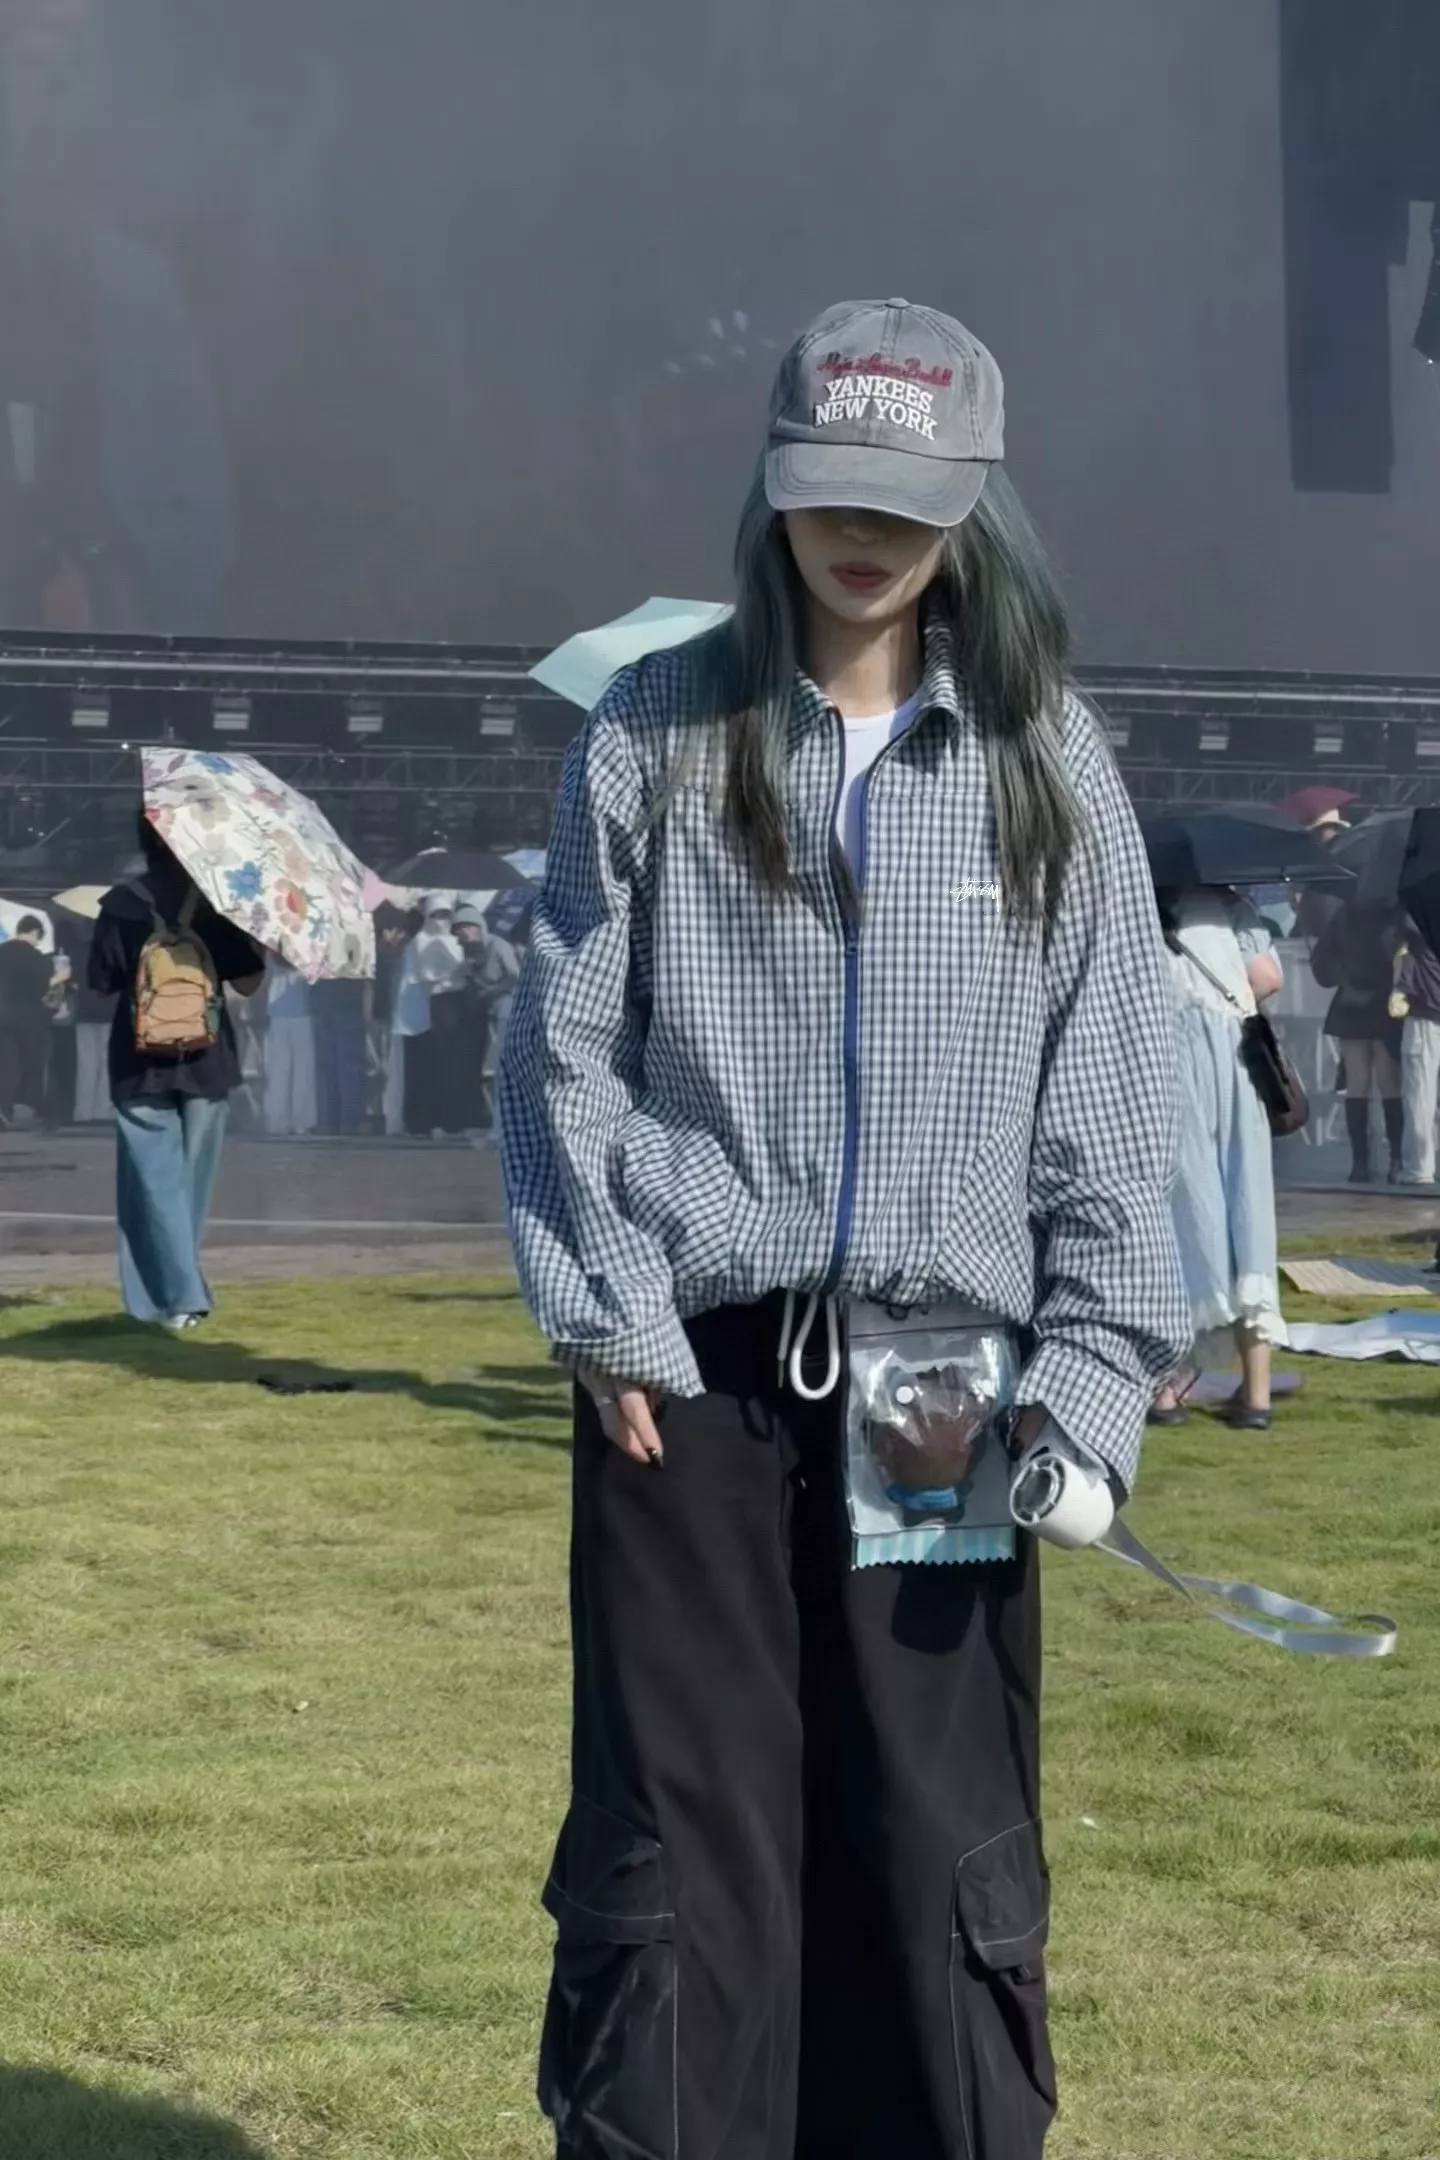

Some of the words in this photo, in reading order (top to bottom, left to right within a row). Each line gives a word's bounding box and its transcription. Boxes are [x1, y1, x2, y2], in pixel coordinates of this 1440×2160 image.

[825, 375, 934, 414] YANKEES
[814, 397, 871, 427] NEW
[873, 399, 938, 440] YORK
